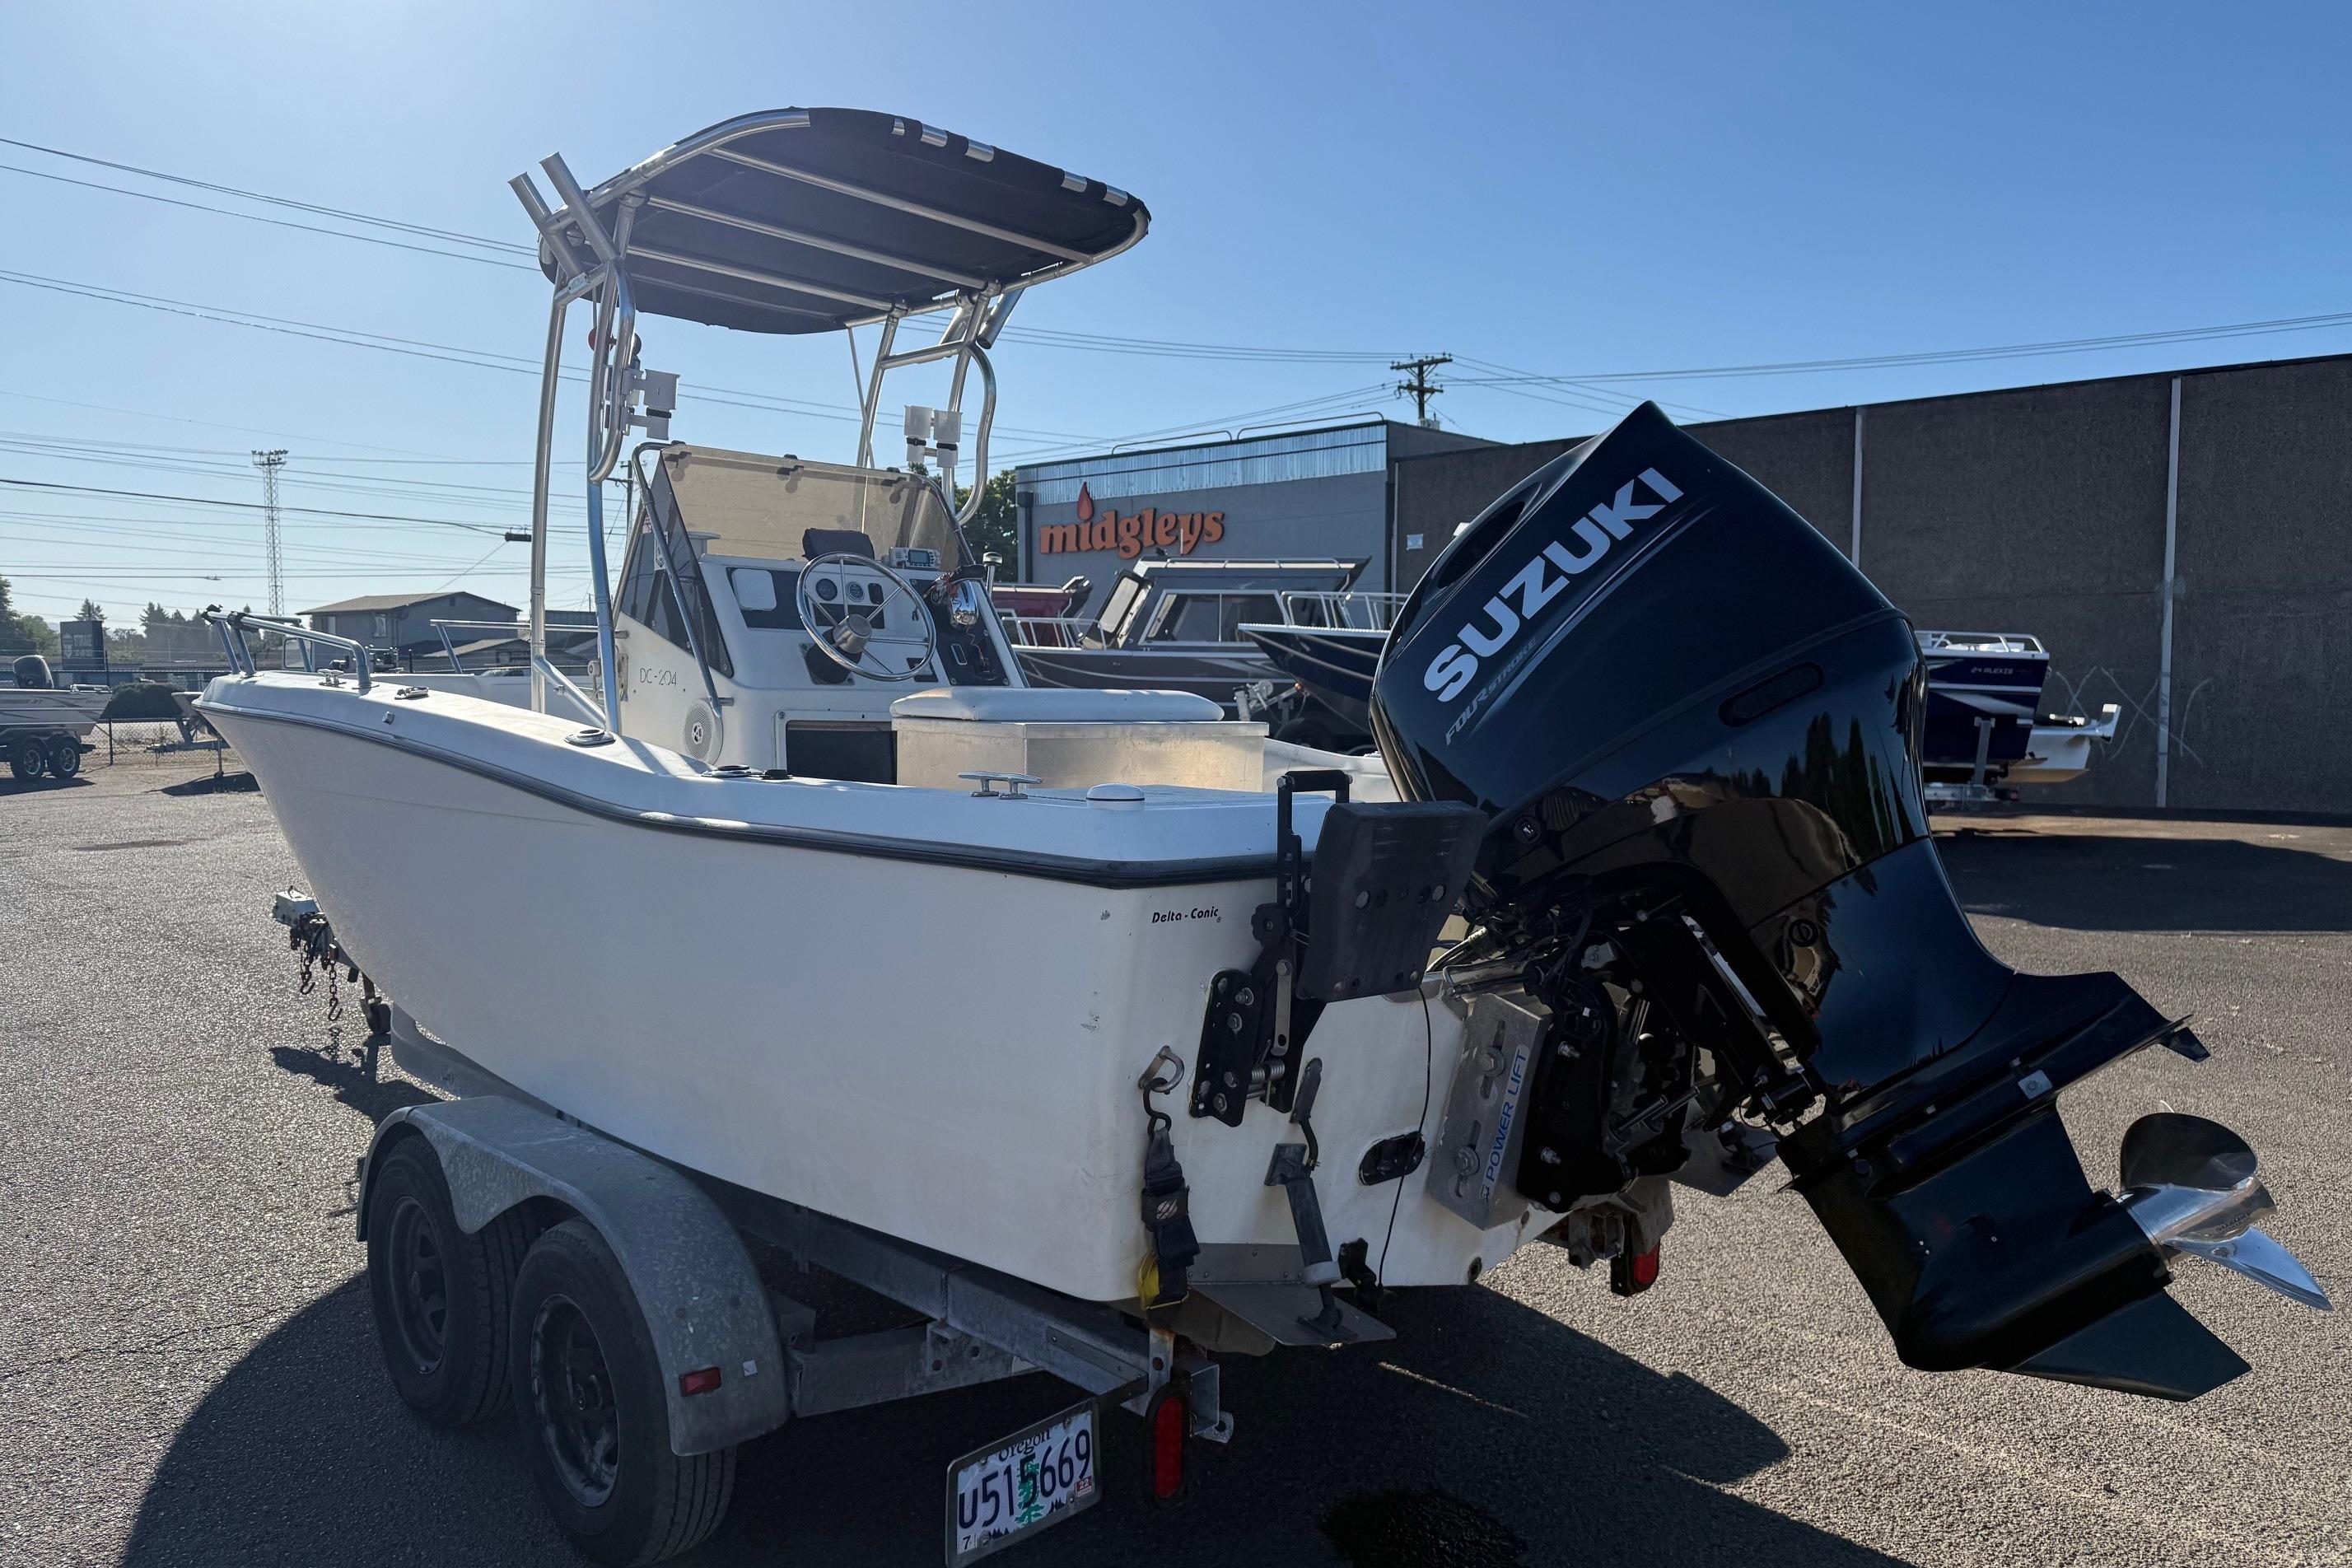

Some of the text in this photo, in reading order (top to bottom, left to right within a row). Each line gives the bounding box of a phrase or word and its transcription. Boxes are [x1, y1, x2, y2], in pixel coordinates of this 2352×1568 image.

[1039, 508, 1225, 560] midgleys
[1424, 467, 1684, 702] SUZUKI
[1486, 1048, 1527, 1183] POWER LIFT
[958, 1429, 1091, 1529] U515669
[997, 1428, 1051, 1463] Oregon
